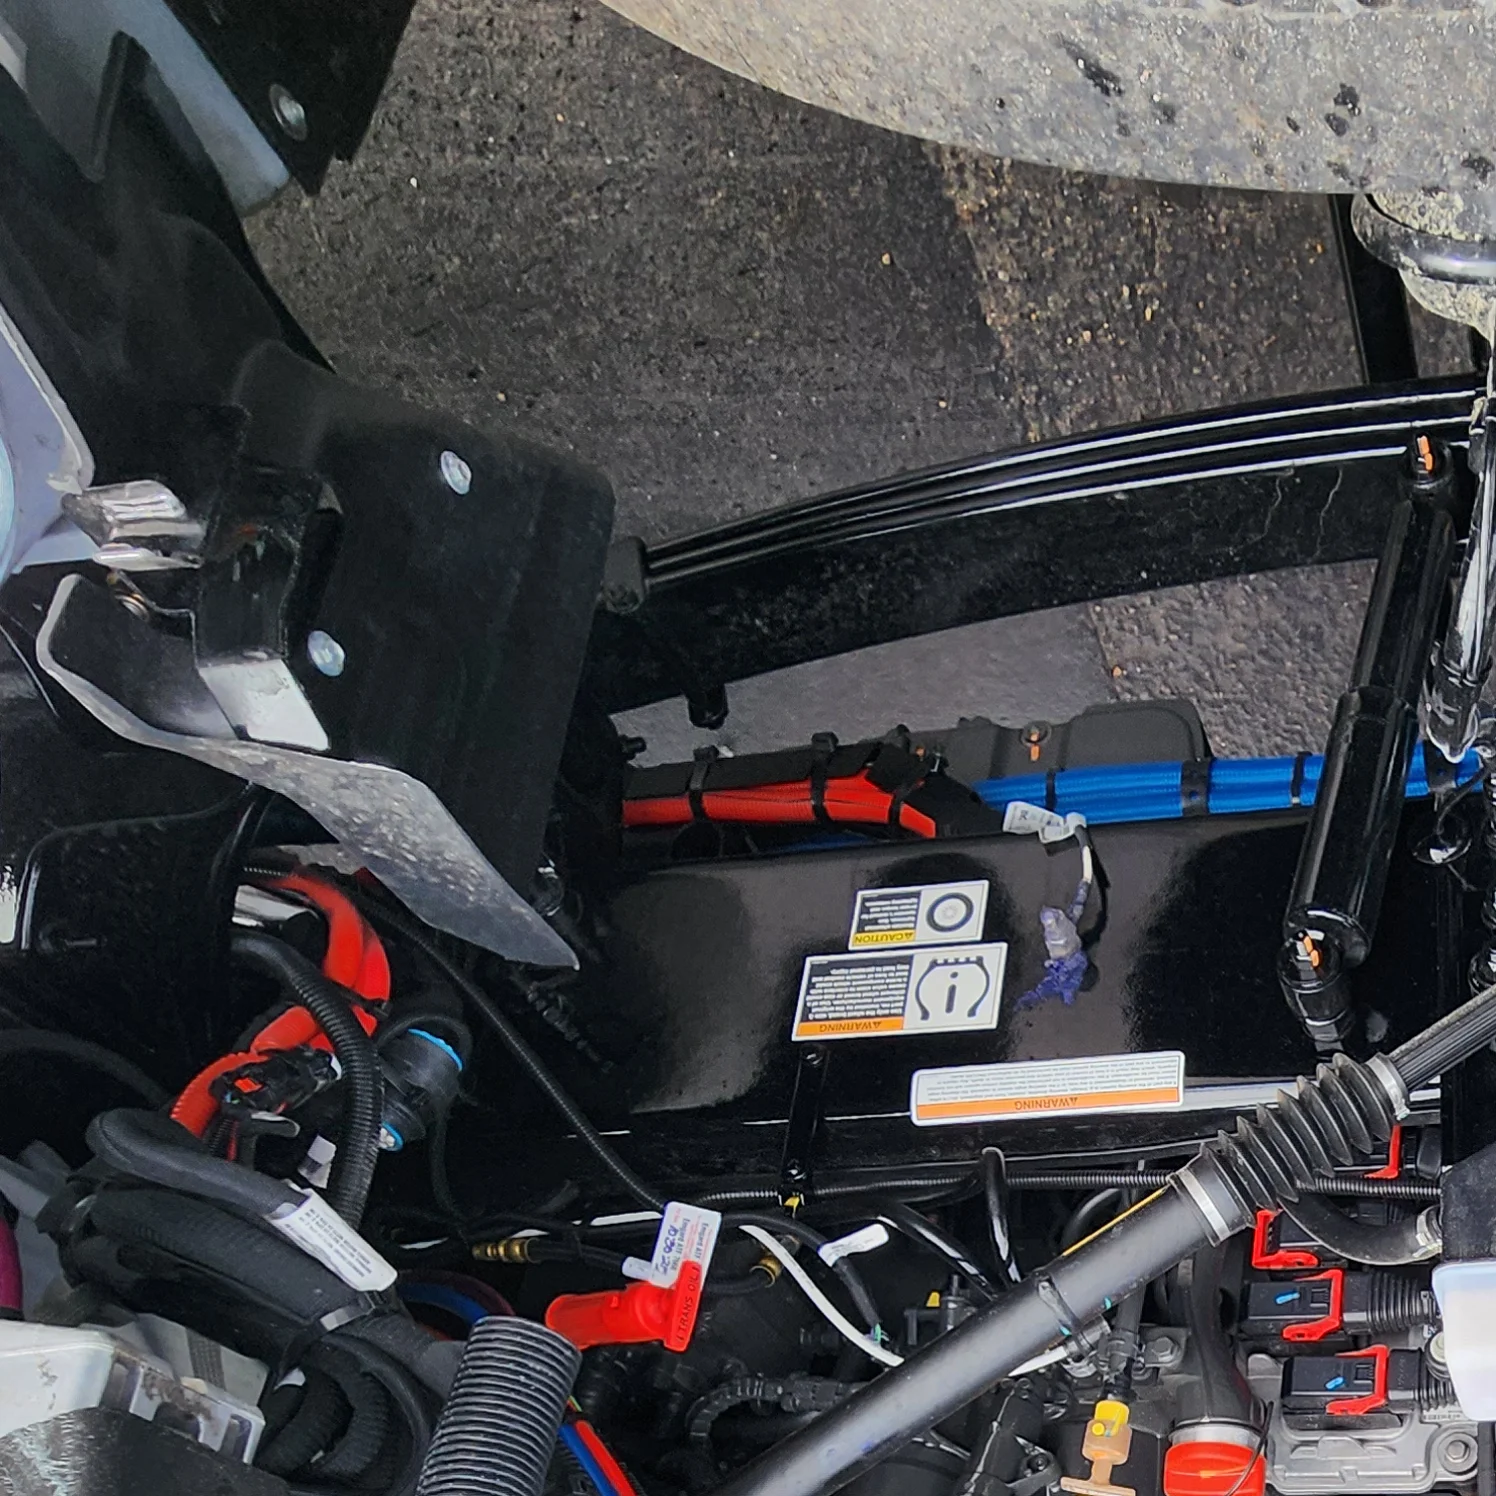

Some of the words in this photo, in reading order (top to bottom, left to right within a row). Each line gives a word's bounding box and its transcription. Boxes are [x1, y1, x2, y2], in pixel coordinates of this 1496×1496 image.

[854, 932, 904, 944] CAUTION
[819, 1021, 872, 1032] WARNING
[1014, 1097, 1070, 1110] WARNING
[676, 1296, 692, 1334] TRANS
